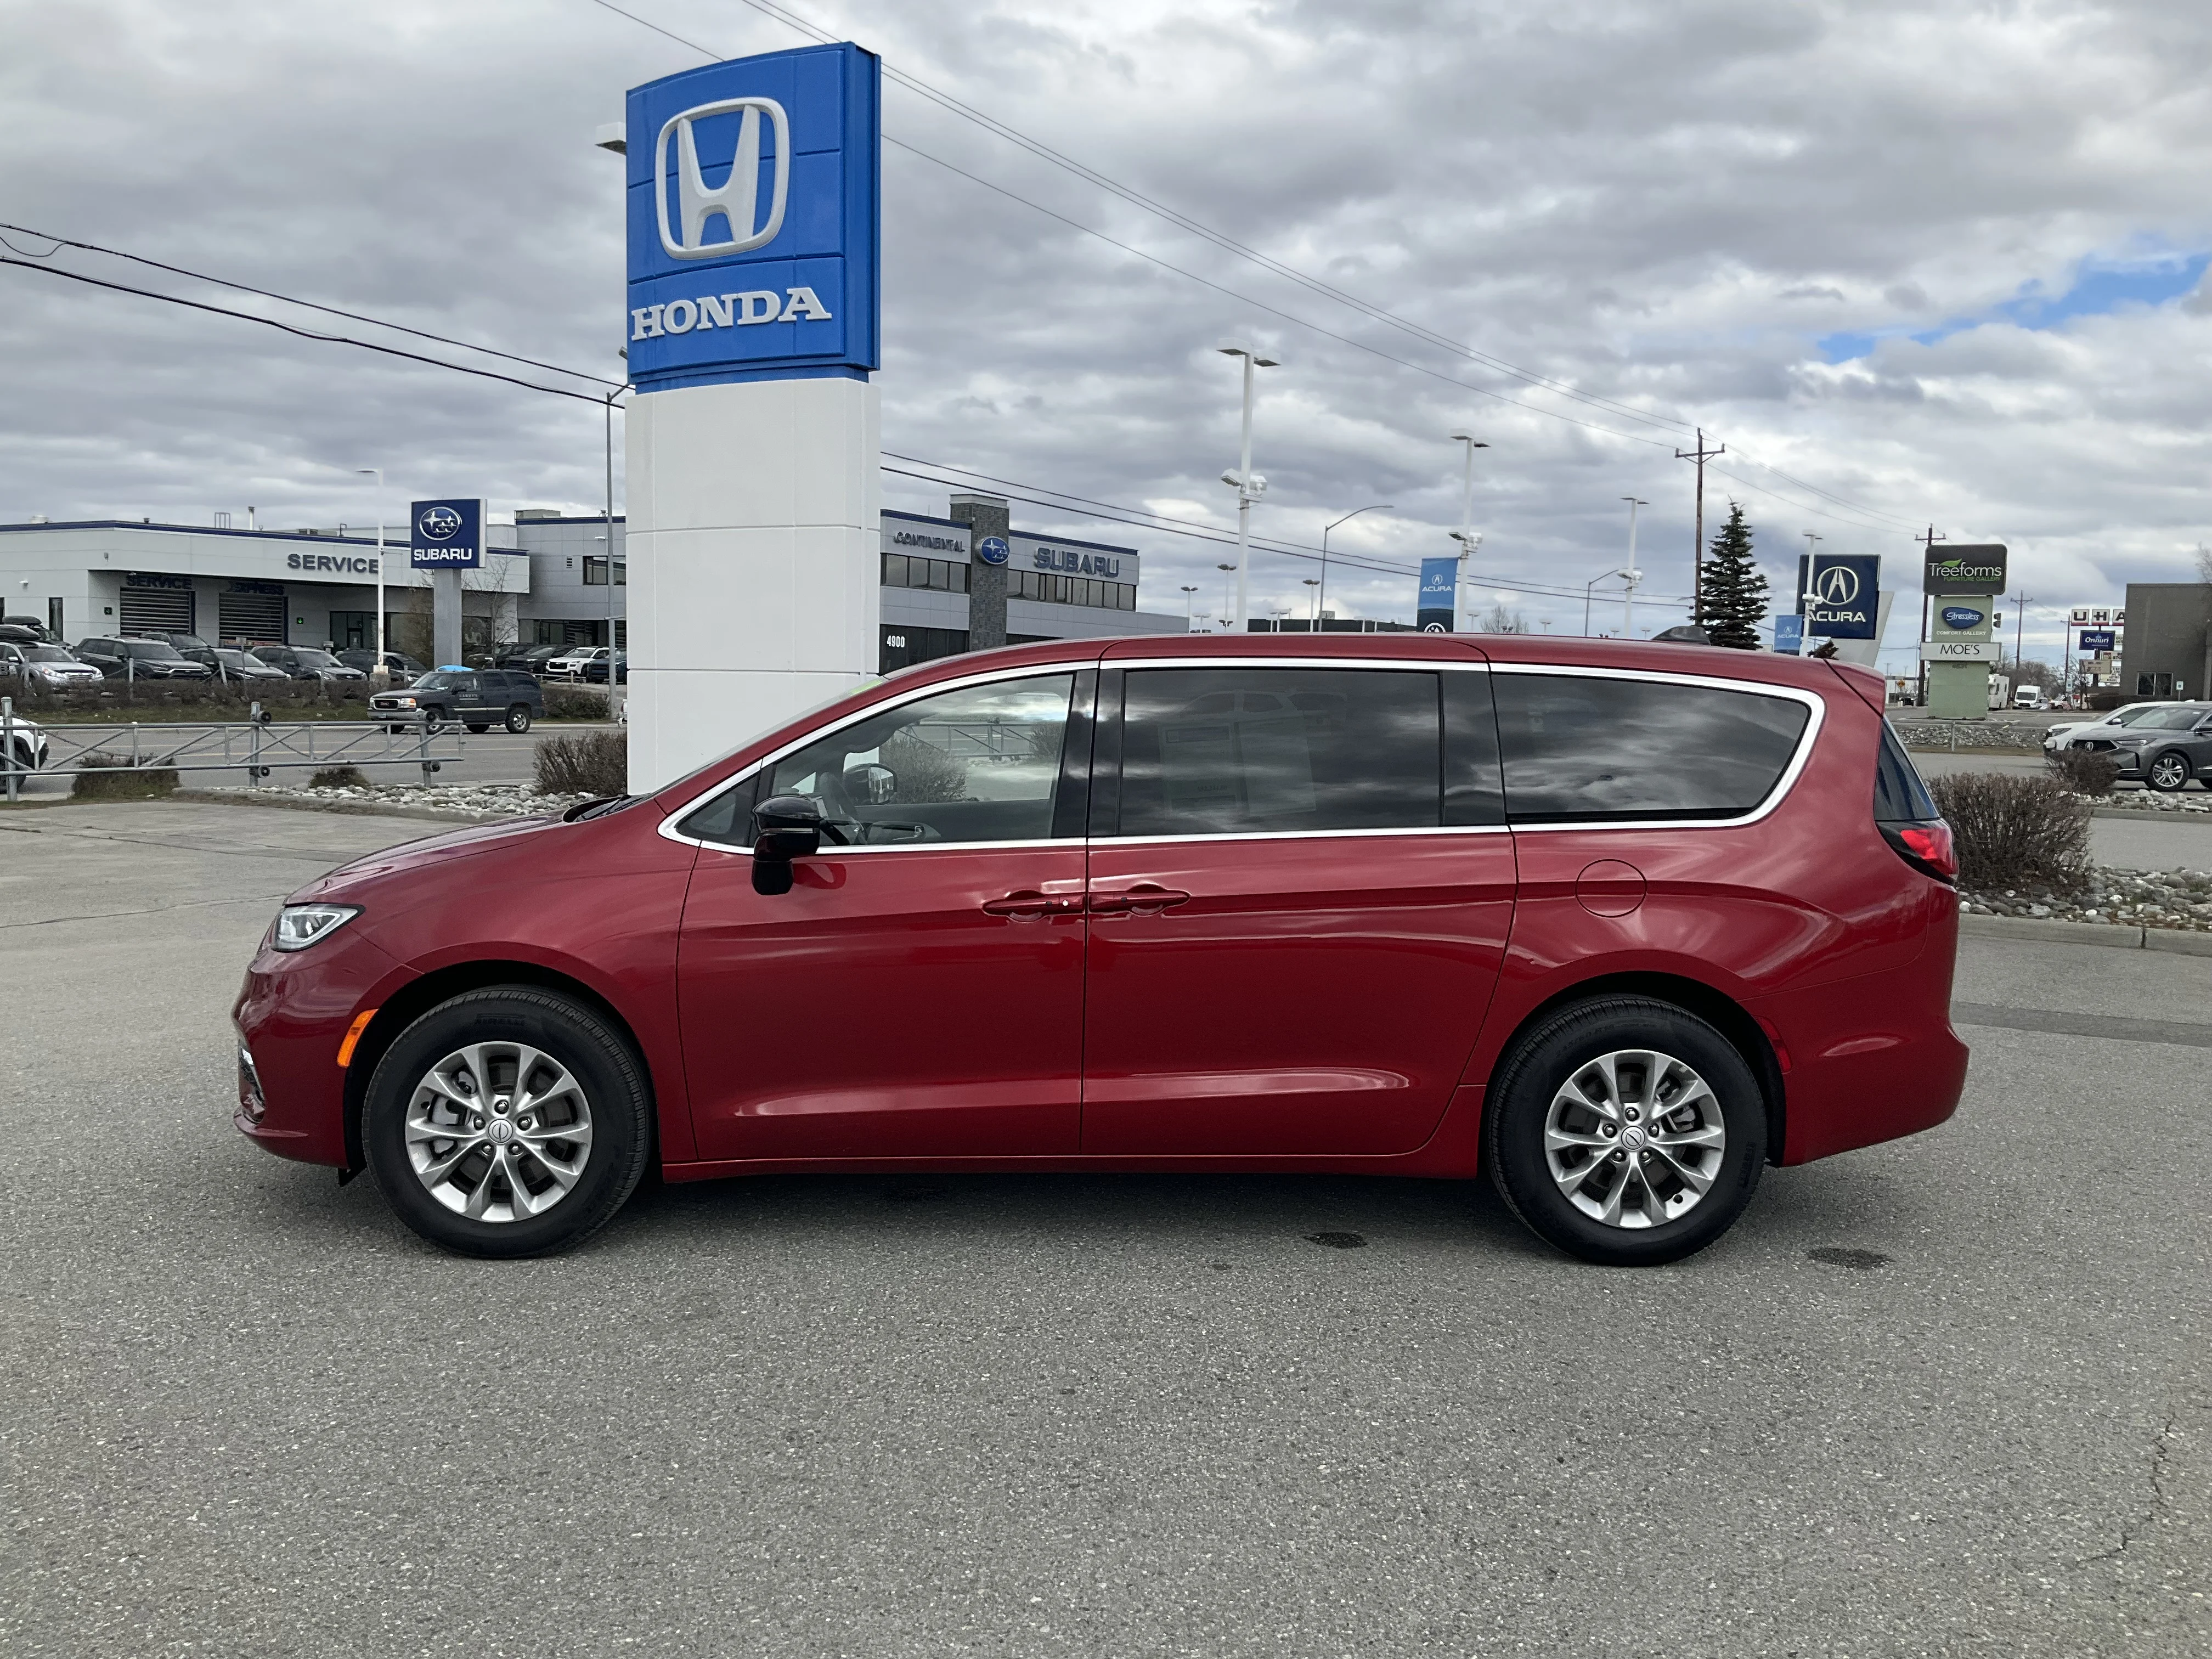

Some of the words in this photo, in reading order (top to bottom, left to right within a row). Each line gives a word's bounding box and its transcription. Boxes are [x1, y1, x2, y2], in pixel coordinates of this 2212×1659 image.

[631, 287, 833, 341] HONDA
[894, 532, 966, 552] CONTINENTAL
[414, 548, 472, 561] SUBARU
[1034, 547, 1120, 578] SUBARU
[287, 553, 379, 574] SERVICE
[1928, 561, 2002, 577] Treeforms
[126, 574, 193, 590] SERVICE
[1946, 612, 1979, 621] Stressless
[887, 635, 905, 648] 4900
[1940, 644, 1980, 654] MOE'S
